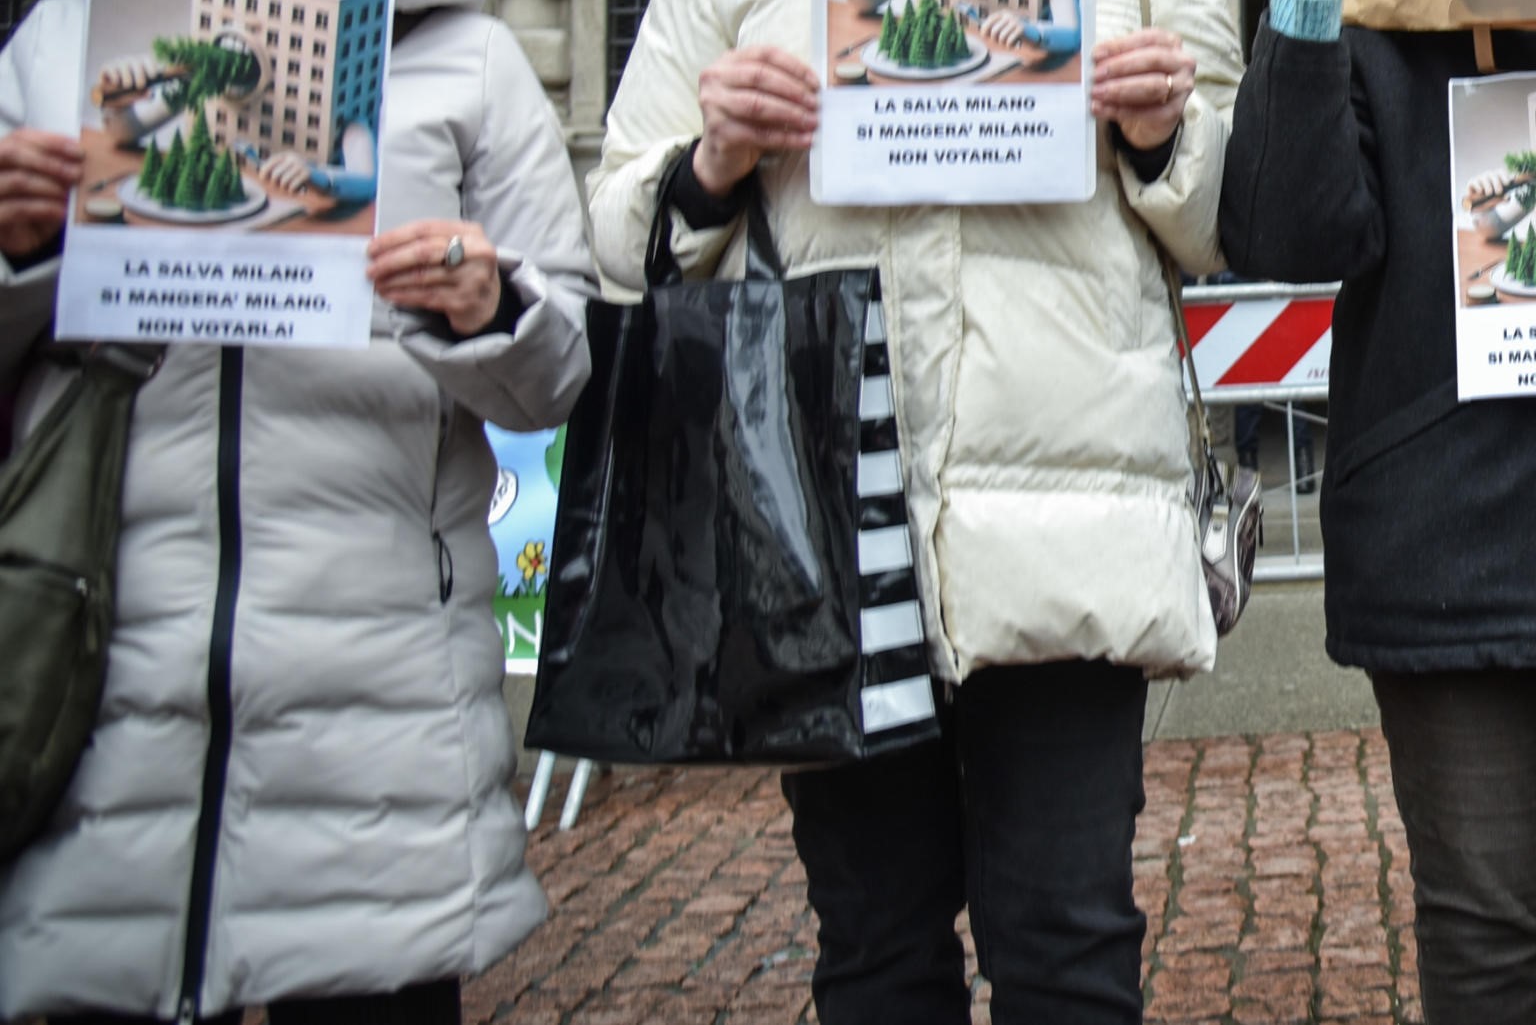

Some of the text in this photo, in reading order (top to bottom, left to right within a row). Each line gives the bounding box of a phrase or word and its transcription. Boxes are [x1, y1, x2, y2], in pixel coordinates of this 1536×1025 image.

[875, 96, 1036, 113] LA SALVA MILANO
[857, 122, 1053, 140] SI MANGERA' MILANO.
[889, 148, 1022, 164] NON VOTARLA!
[124, 259, 314, 283] LA SALVA MILANO
[100, 287, 120, 304] SI
[128, 289, 239, 309] MANGERA'
[137, 318, 294, 339] NON VOTARLA!
[1503, 327, 1523, 340] LA
[1488, 351, 1502, 365] SI
